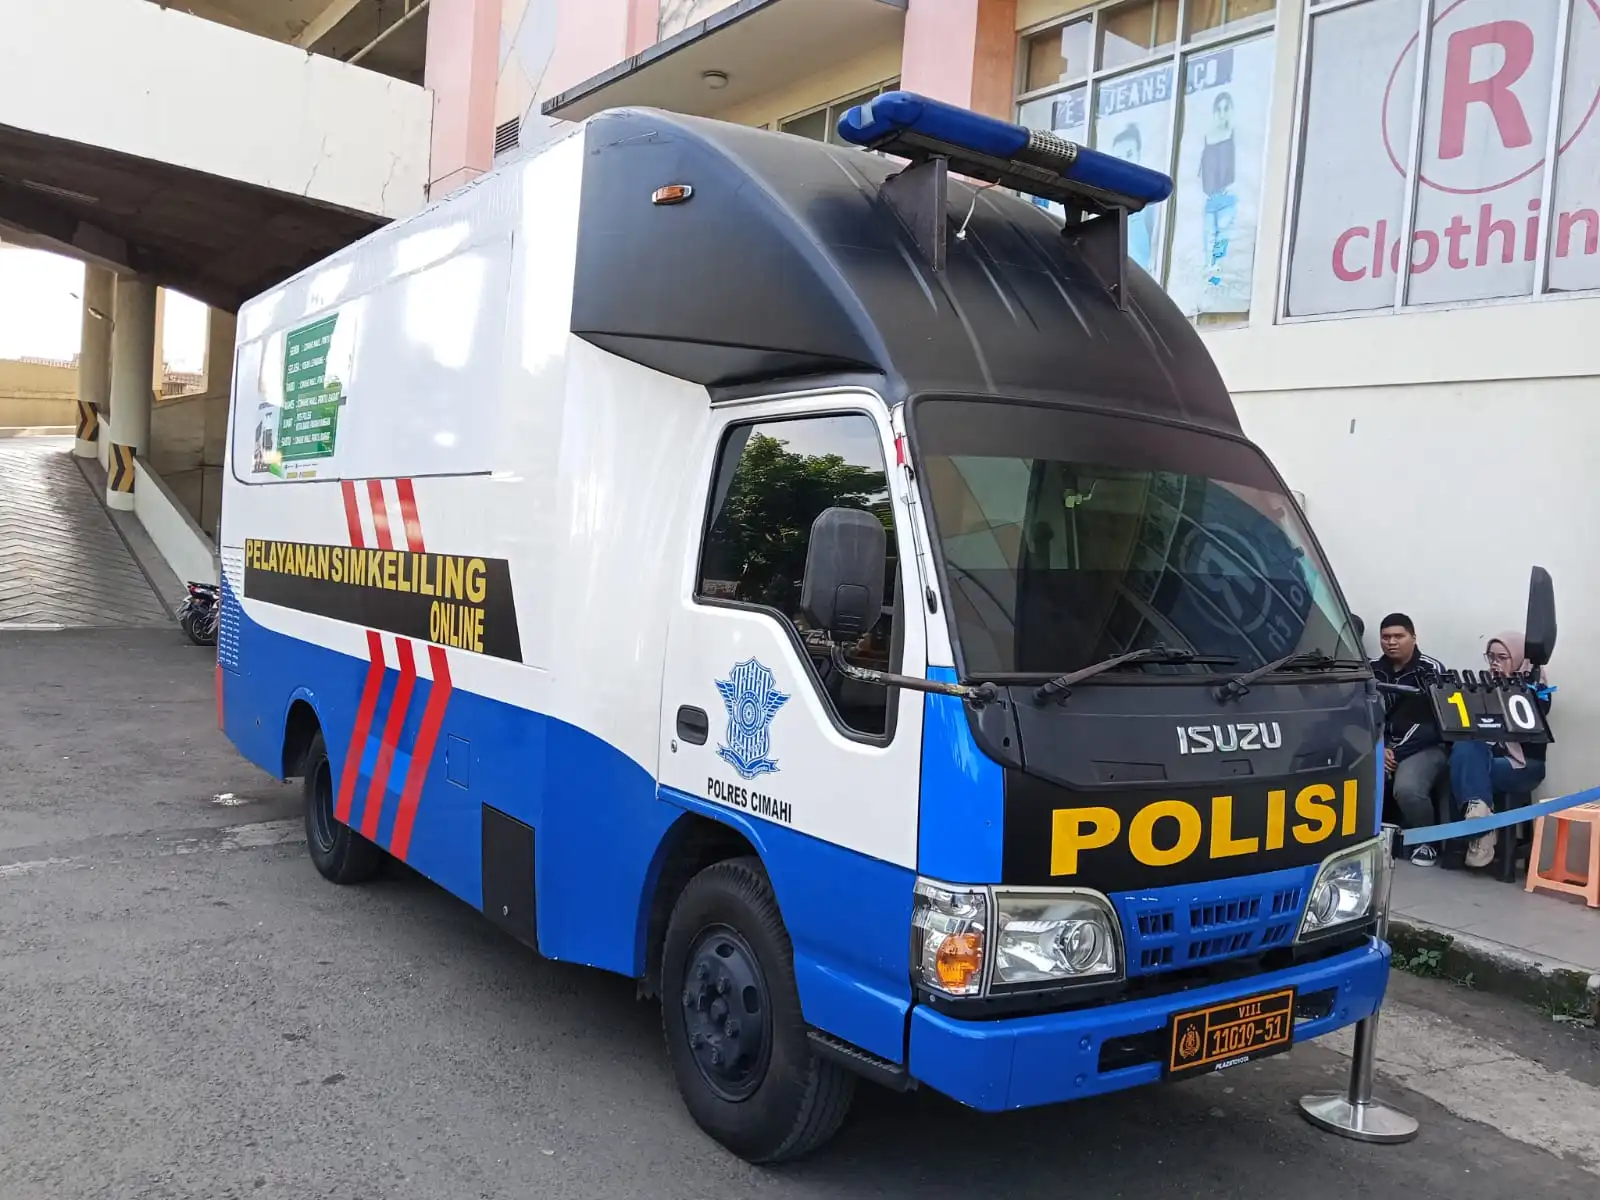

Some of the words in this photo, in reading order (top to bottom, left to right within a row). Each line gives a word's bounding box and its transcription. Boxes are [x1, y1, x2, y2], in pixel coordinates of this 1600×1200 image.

[1105, 74, 1167, 113] JEANS
[1438, 20, 1534, 160] R
[430, 600, 485, 653] ONLINE
[1447, 692, 1471, 728] 1
[1508, 694, 1536, 730] 0
[1176, 721, 1282, 755] ISUZU
[707, 777, 748, 808] POLRES
[750, 791, 793, 823] CIMAHI
[1050, 779, 1358, 877] POLISI
[1239, 1003, 1261, 1018] VIII
